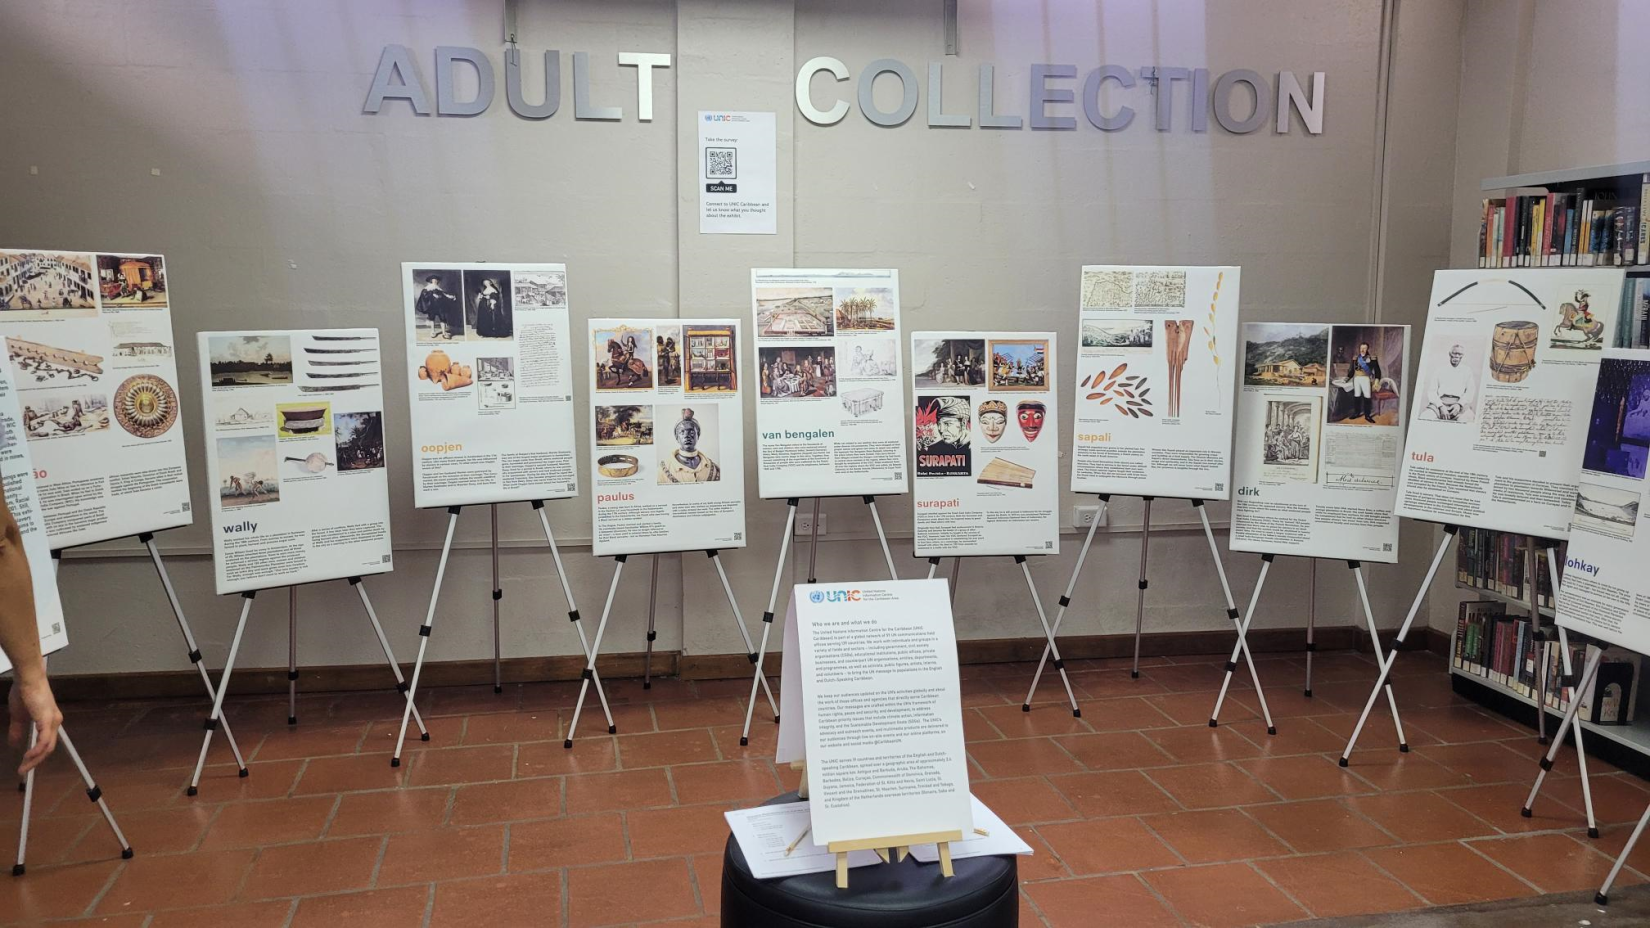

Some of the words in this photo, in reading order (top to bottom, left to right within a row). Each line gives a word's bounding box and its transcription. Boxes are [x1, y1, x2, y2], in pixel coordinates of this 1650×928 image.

[362, 44, 671, 122] ADULT
[795, 56, 1326, 133] COLLECTION
[785, 429, 834, 440] bengalen
[1078, 433, 1111, 443] sapali
[421, 442, 462, 454] oopjen
[919, 454, 965, 467] SURAPATI
[1411, 452, 1434, 463] tula
[1238, 486, 1260, 496] dirk
[597, 492, 634, 504] paulus
[917, 498, 959, 509] surapati
[223, 521, 258, 533] wally
[826, 589, 861, 602] UNIC
